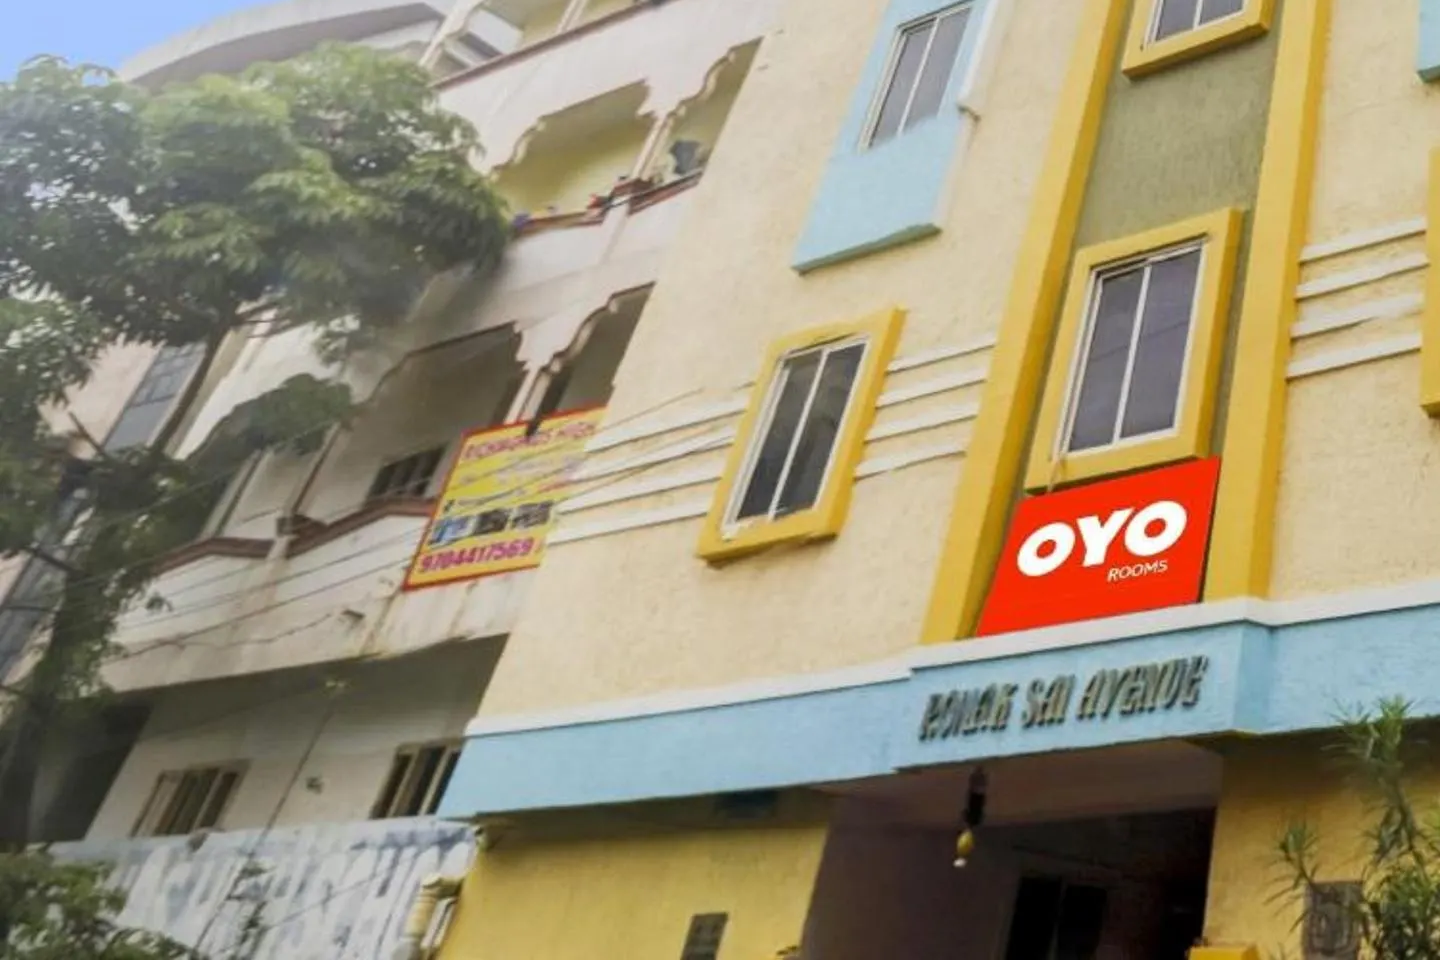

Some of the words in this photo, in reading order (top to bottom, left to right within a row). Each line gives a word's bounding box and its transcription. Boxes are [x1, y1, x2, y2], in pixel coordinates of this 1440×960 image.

[1016, 499, 1188, 577] OYO
[1106, 559, 1169, 583] ROOMS
[1021, 674, 1076, 729] SAI
[1077, 654, 1210, 720] AVENUE
